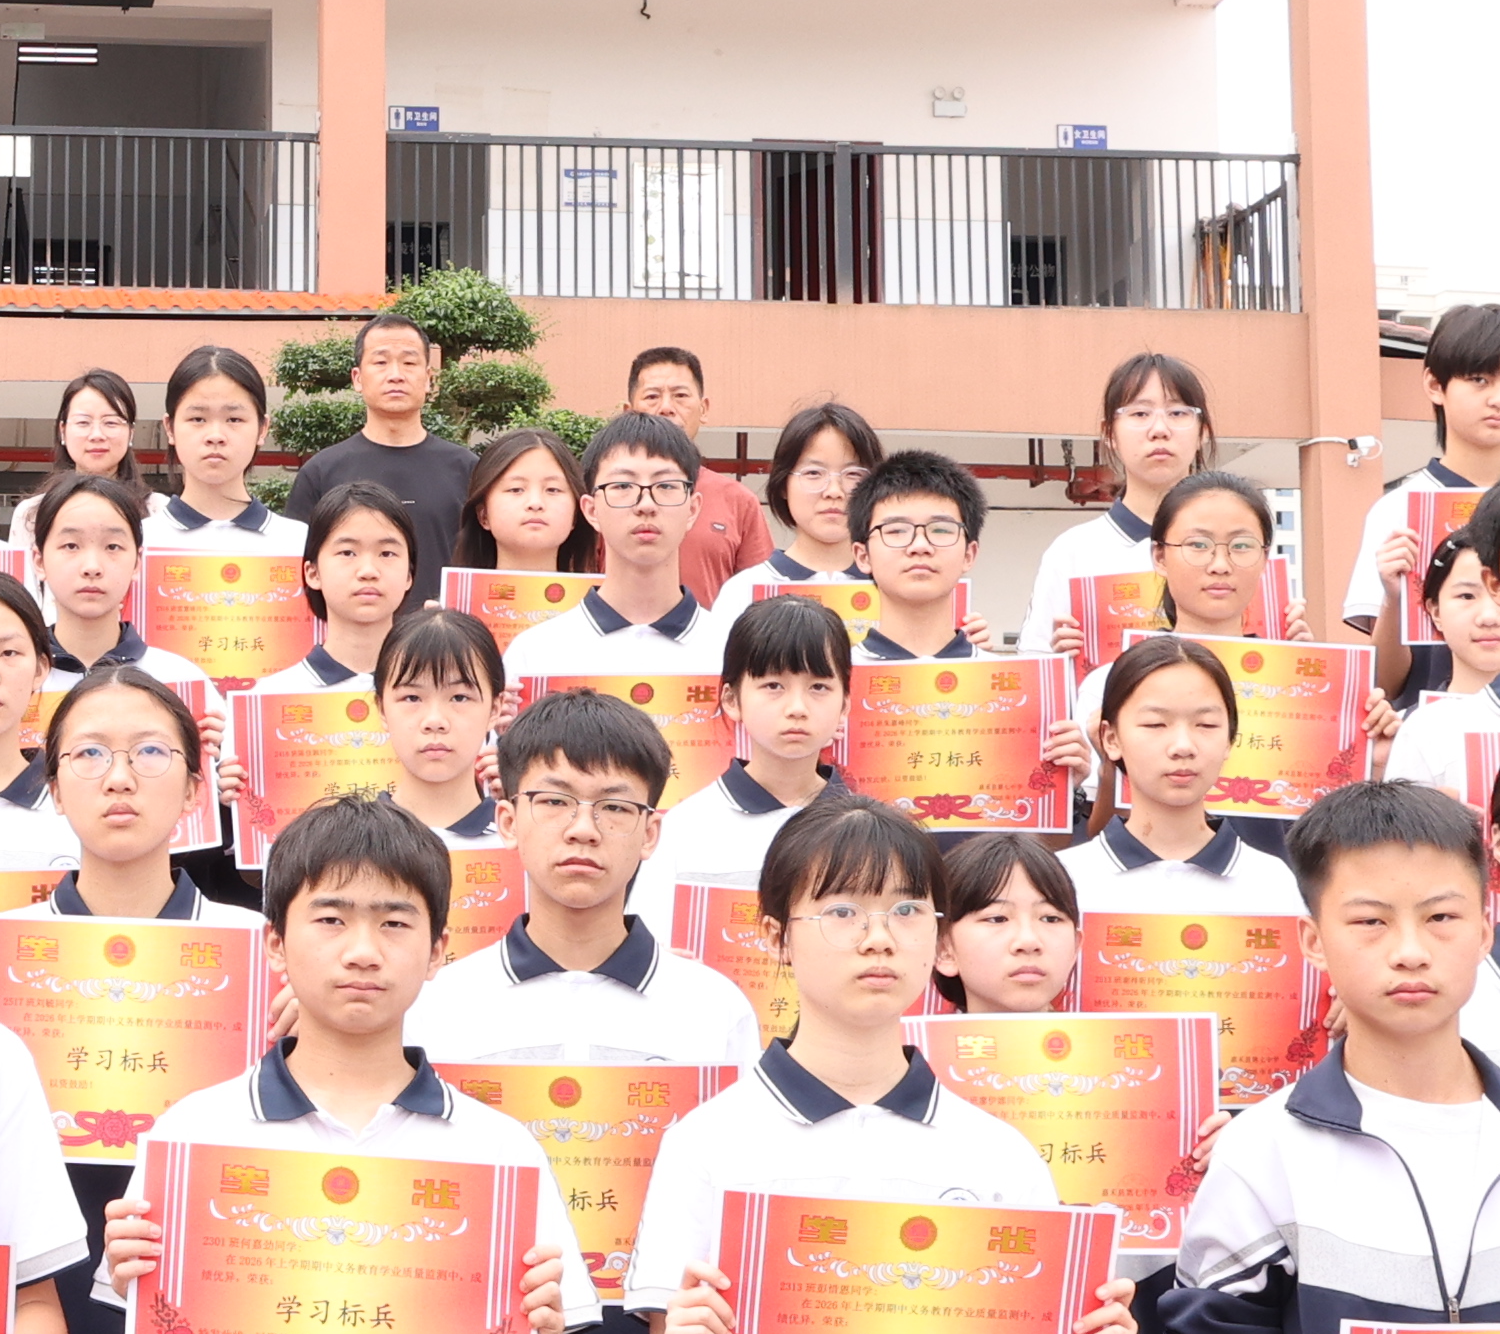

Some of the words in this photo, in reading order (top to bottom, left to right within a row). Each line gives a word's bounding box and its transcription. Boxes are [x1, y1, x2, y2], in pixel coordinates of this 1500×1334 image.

[406, 112, 437, 121] 男卫生间
[1074, 130, 1105, 140] 女卫生间
[270, 566, 296, 583] 状
[198, 635, 265, 652] 学习标兵
[1296, 657, 1326, 677] 状
[990, 671, 1021, 691] 状
[907, 751, 983, 768] 学习标兵
[1246, 929, 1280, 948] 状
[180, 943, 221, 968] 状
[1114, 1035, 1154, 1057] 状
[66, 1047, 169, 1073] 学习标兵
[628, 1082, 670, 1107] 状
[412, 1179, 460, 1210] 状
[568, 1188, 618, 1211] 标兵
[988, 1226, 1036, 1254] 状
[276, 1296, 395, 1329] 学习标兵
